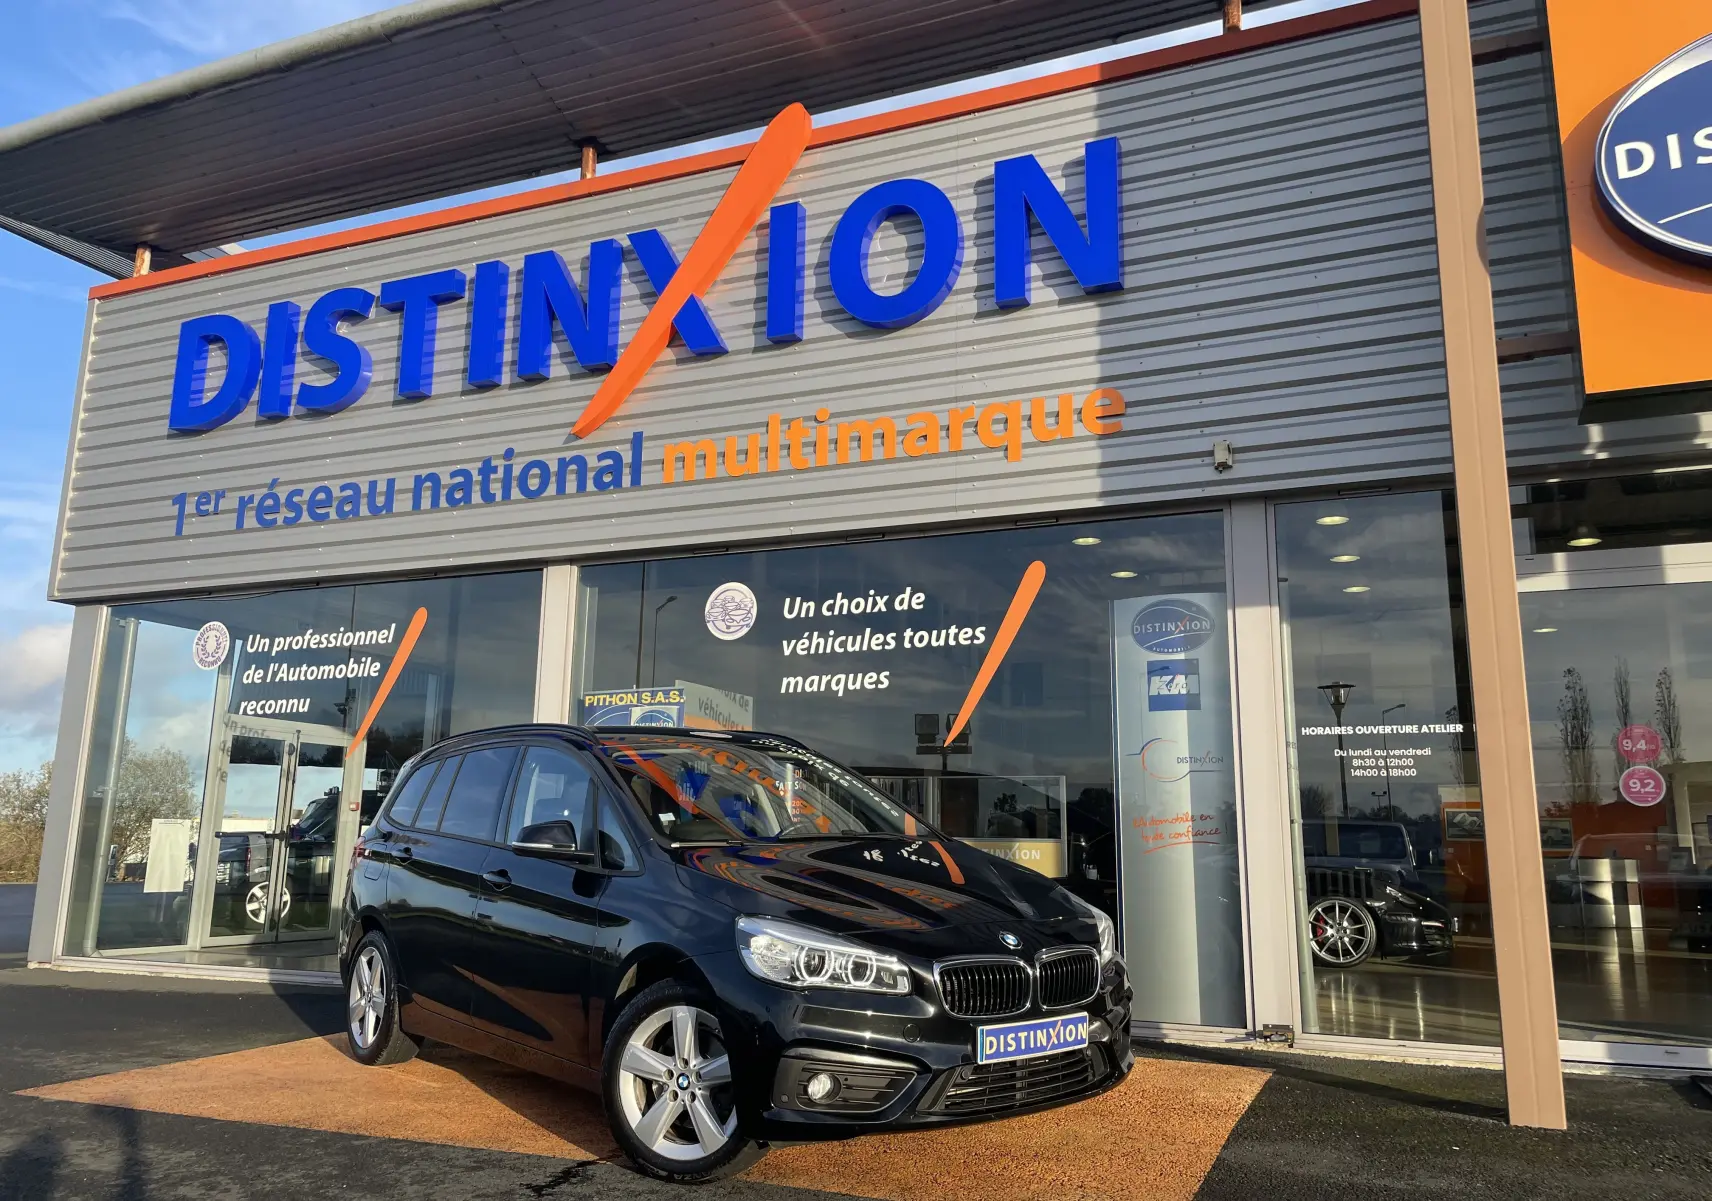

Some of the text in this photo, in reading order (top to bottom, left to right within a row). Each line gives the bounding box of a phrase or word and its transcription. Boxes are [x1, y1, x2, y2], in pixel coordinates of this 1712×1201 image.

[1614, 126, 1712, 180] DIS
[168, 102, 1124, 438] DISTINXION
[171, 386, 1127, 536] 1er réseau national multimarque
[782, 586, 926, 619] Un choix de
[1133, 615, 1211, 635] DISTINXION
[246, 622, 397, 657] Un professionnel
[781, 624, 987, 657] véhicules toutes
[242, 656, 381, 684] de l'Automobile
[780, 670, 890, 697] marques
[238, 697, 311, 715] reconnu
[585, 690, 685, 707] PITHON S.A.S.
[1301, 726, 1354, 736] HORAIRES
[1355, 725, 1419, 735] OUVERTURE
[1421, 723, 1464, 734] ATELIER
[1176, 750, 1224, 767] DISTINXION
[1334, 747, 1432, 757] Du lundi au vendredi
[1352, 757, 1414, 767] 8h30 à 12h00
[1350, 767, 1417, 777] 14h00 à 18h00
[1628, 778, 1656, 794] 9,2
[1200, 813, 1214, 822] en
[1168, 824, 1221, 840] confiance
[979, 842, 1041, 861] TINXION
[985, 1019, 1087, 1055] DISTINXION
